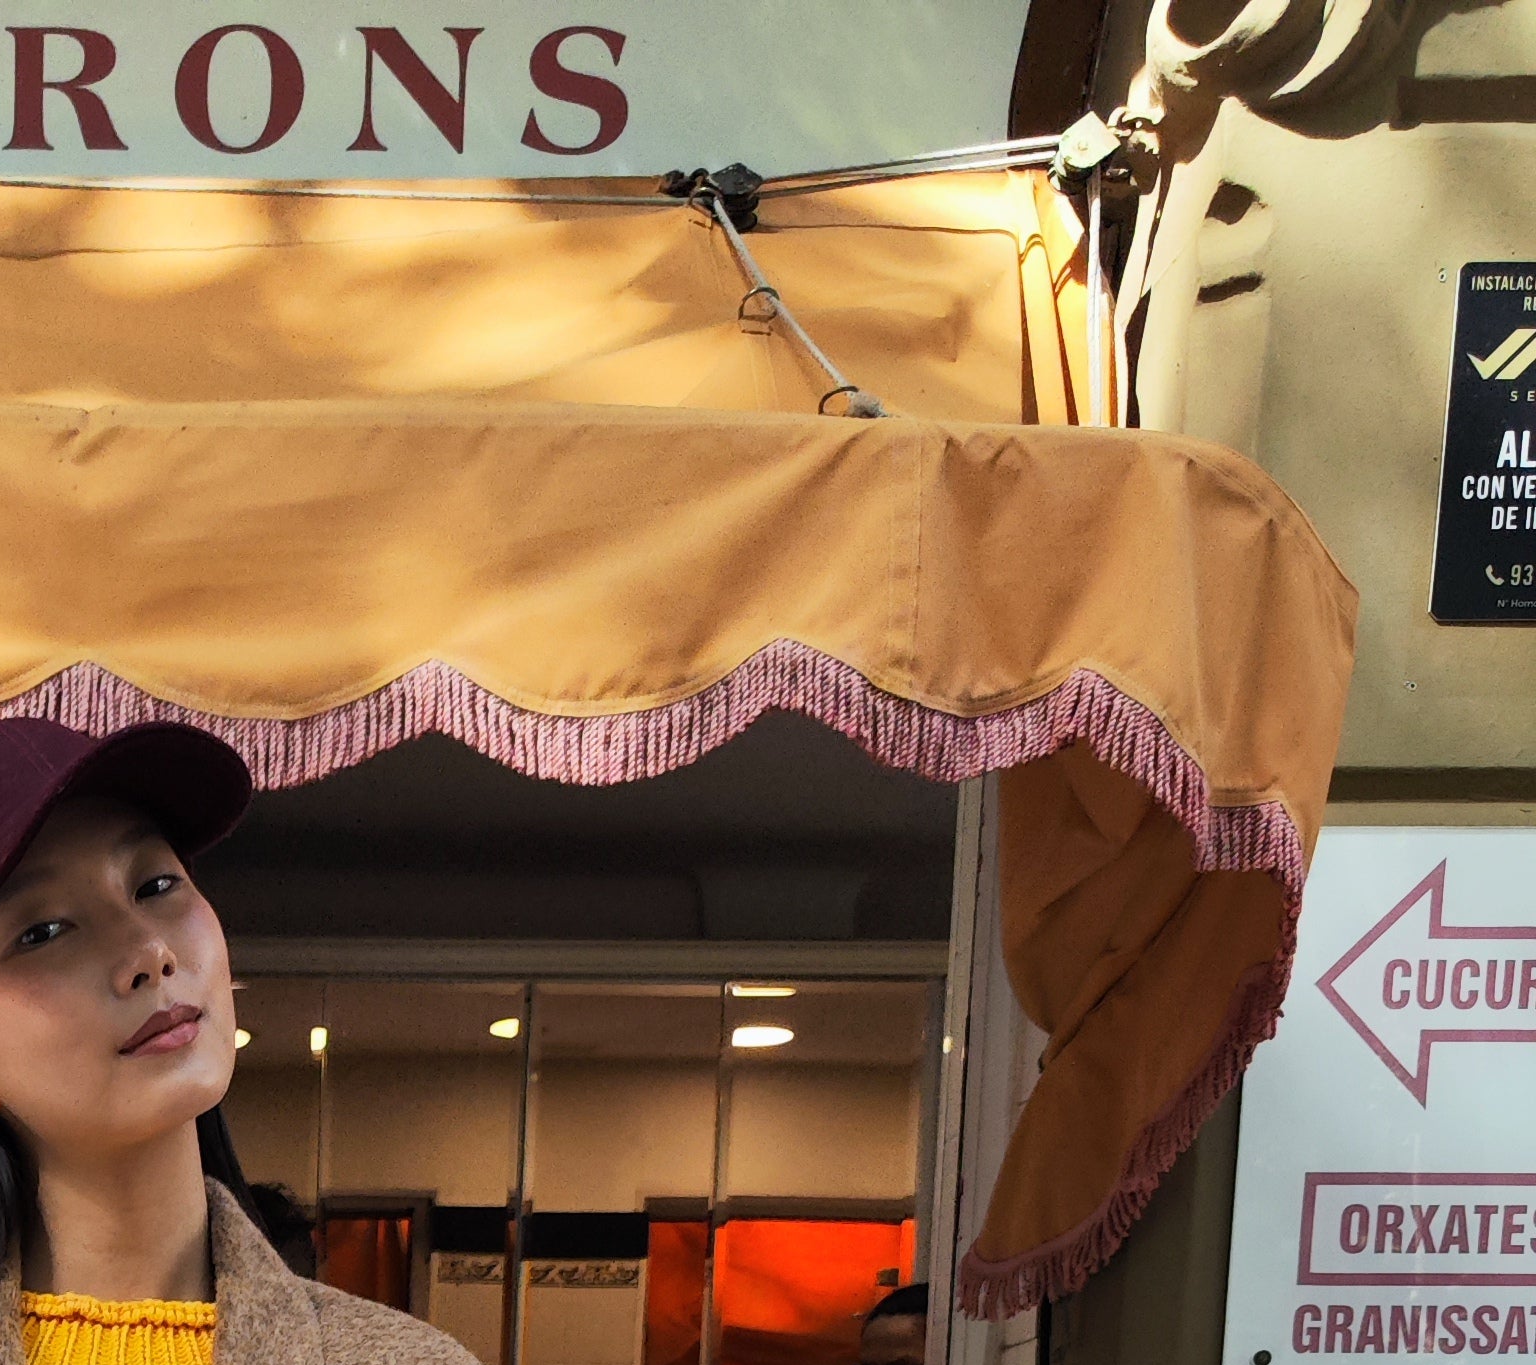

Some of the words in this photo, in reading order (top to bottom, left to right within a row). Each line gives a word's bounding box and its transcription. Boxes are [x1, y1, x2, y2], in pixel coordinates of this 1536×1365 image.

[1497, 430, 1536, 468] AL
[1462, 475, 1505, 500] CON
[1513, 475, 1536, 499] VE
[1491, 506, 1519, 530] DE
[1510, 564, 1534, 586] 93
[1339, 1203, 1536, 1255] ORXATE
[1291, 1304, 1536, 1355] GRANISSA
